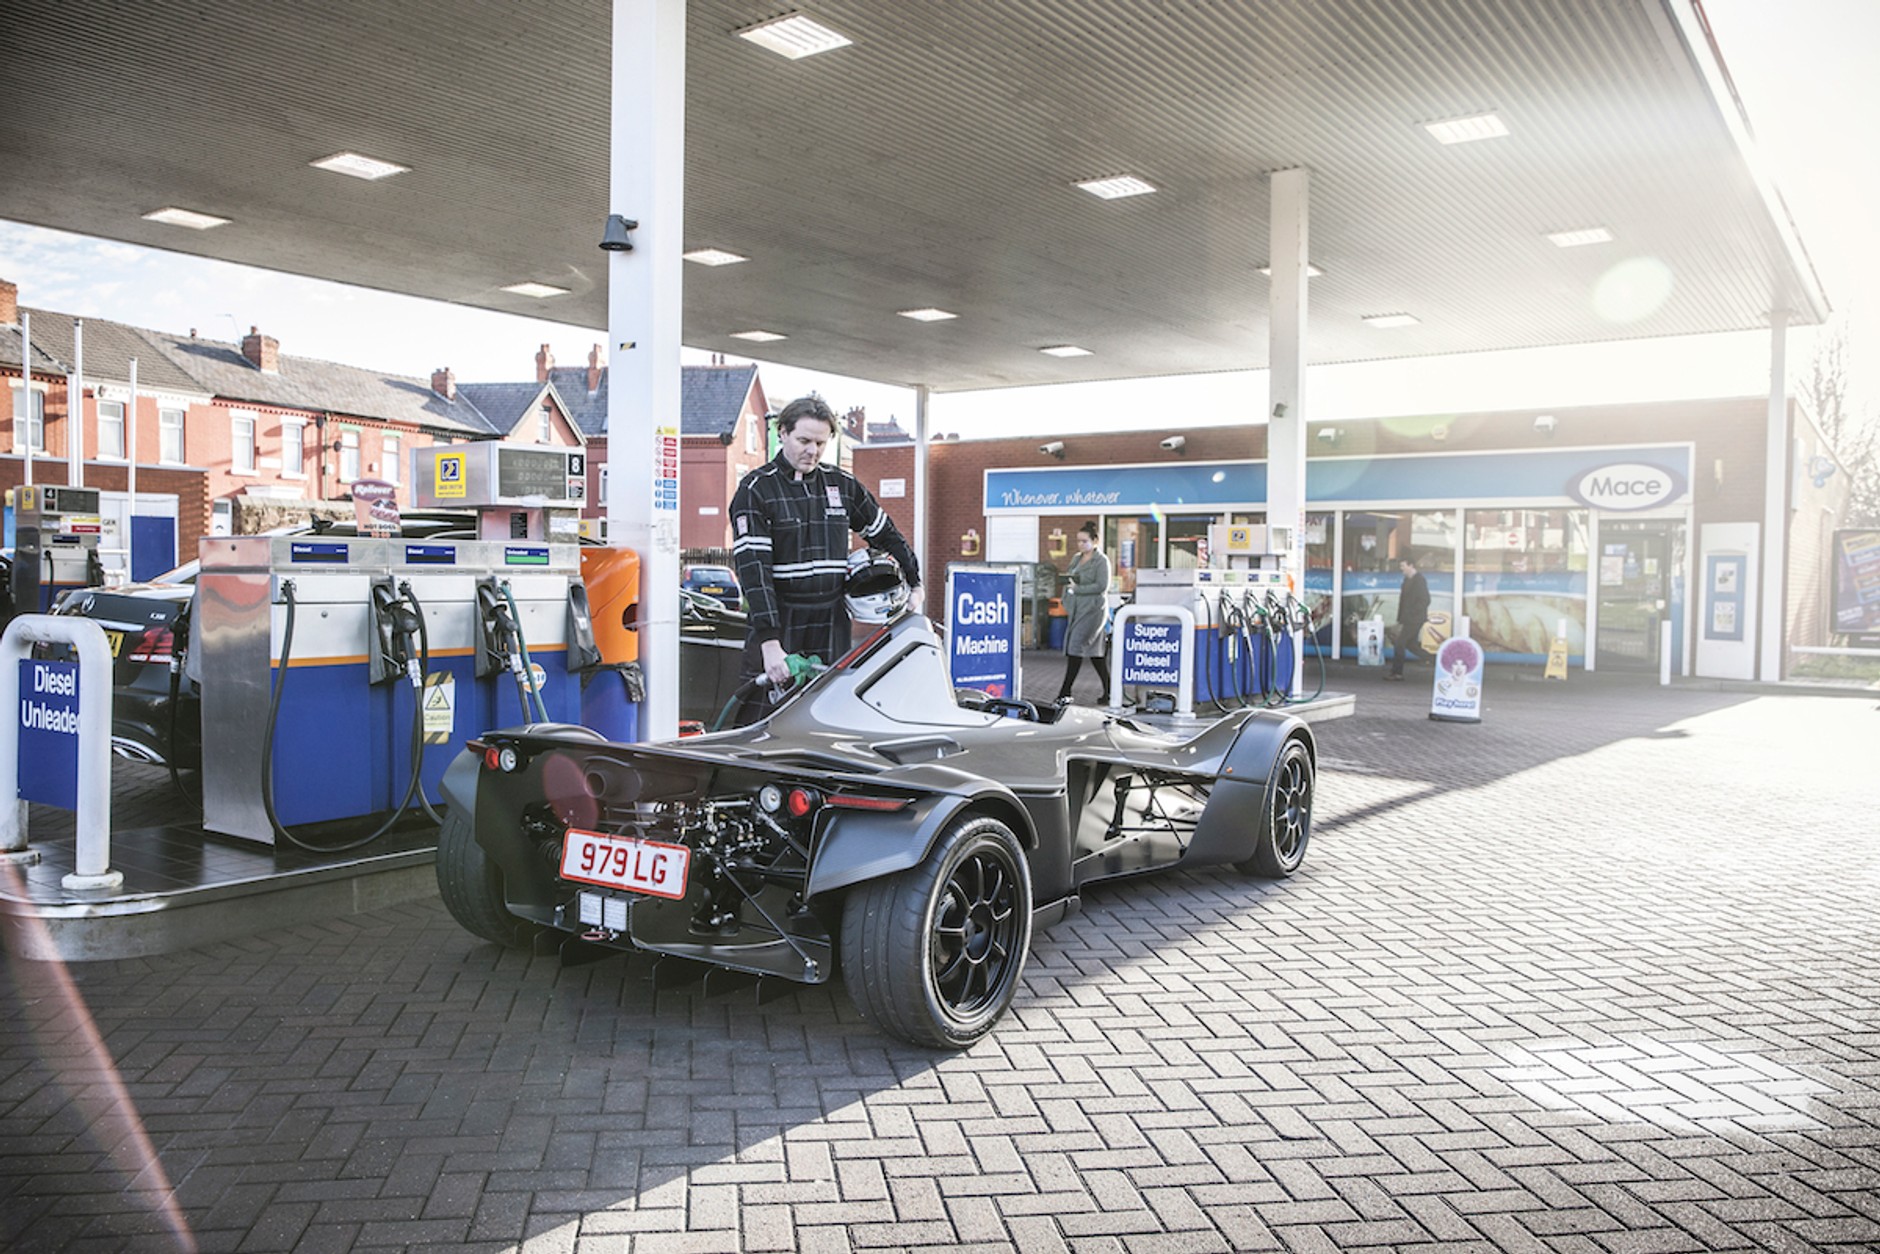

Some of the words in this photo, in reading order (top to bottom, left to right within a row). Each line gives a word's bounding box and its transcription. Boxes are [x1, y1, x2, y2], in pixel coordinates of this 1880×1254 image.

[571, 457, 580, 474] 8
[46, 489, 54, 498] 4
[1589, 476, 1662, 497] Mace
[1002, 488, 1062, 506] Whenever,
[1065, 489, 1120, 505] whatever
[957, 592, 1009, 625] Cash
[1134, 624, 1169, 639] Super
[956, 634, 1009, 655] Machine
[1126, 638, 1179, 652] Unleaded
[1135, 654, 1170, 667] Diesel
[34, 665, 76, 696] Diesel
[1124, 668, 1179, 683] Unleaded
[581, 842, 628, 877] 979
[633, 850, 668, 884] LG
